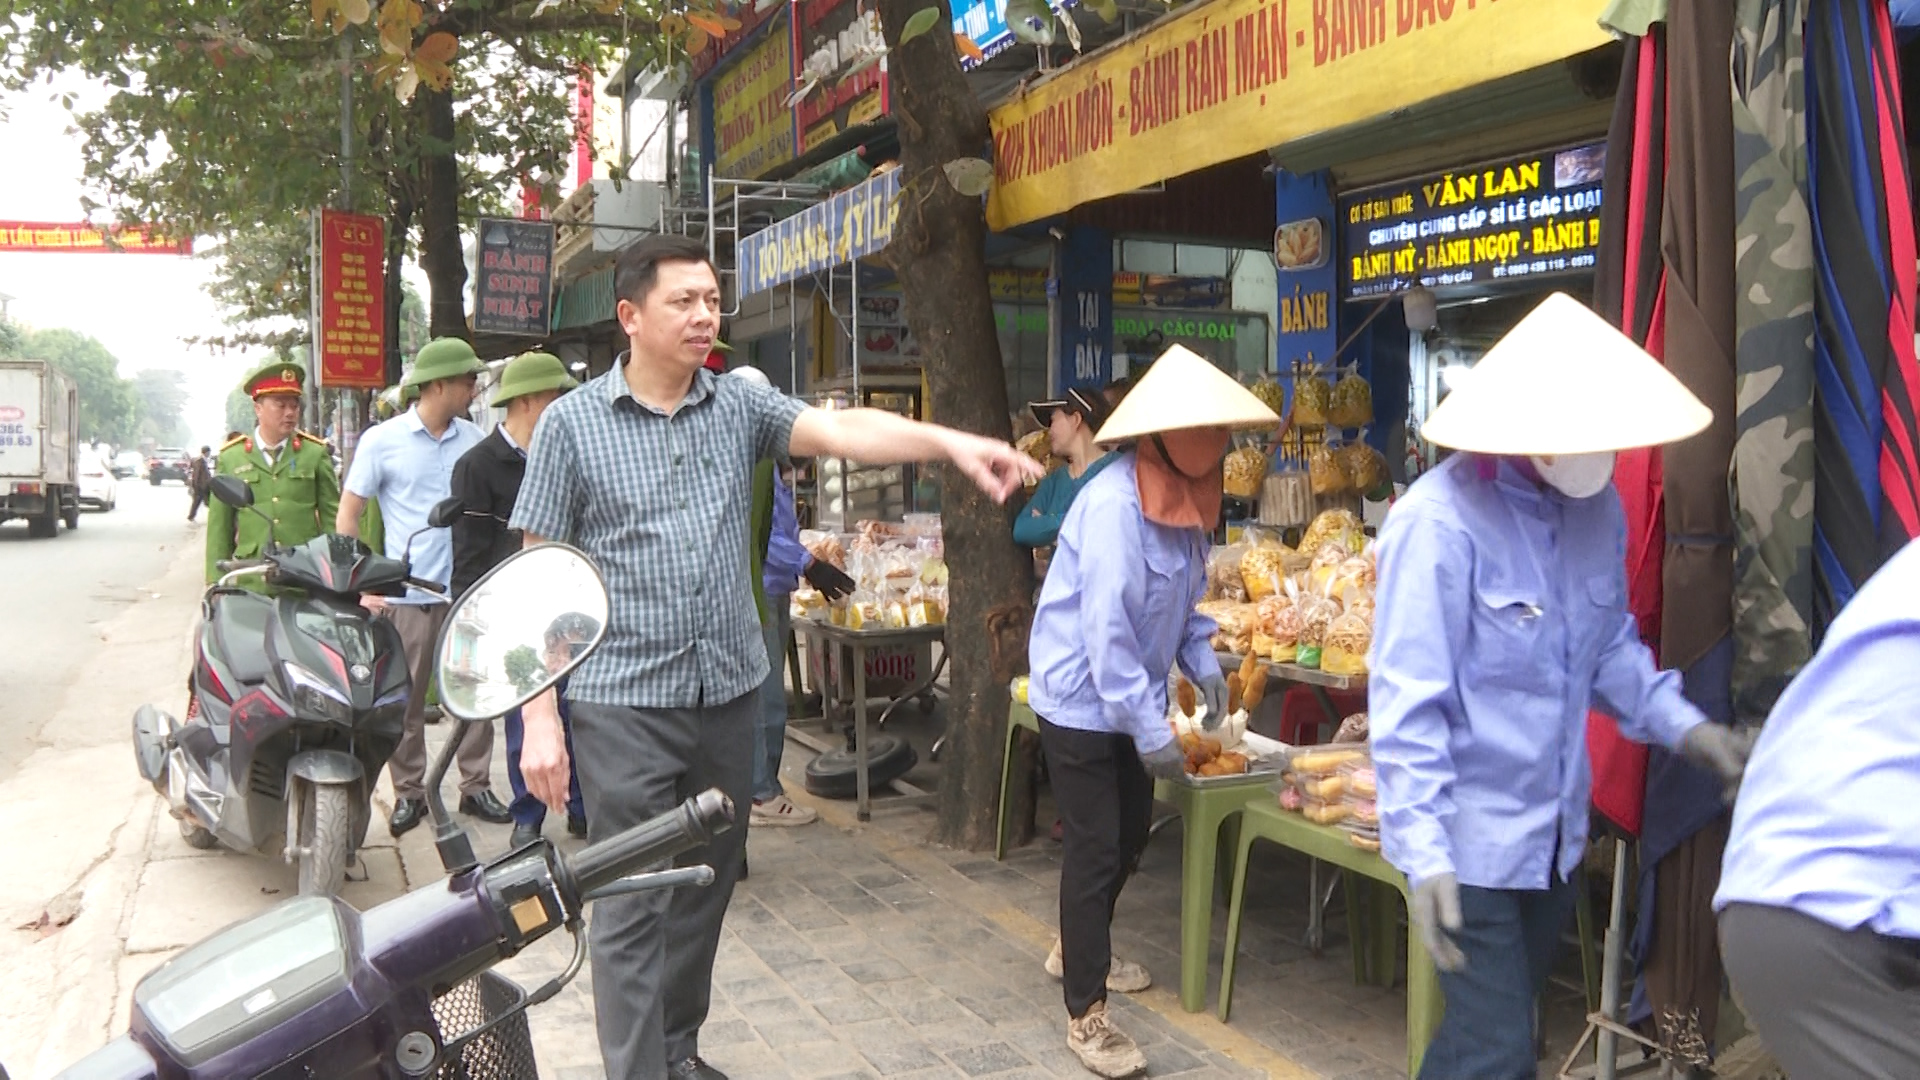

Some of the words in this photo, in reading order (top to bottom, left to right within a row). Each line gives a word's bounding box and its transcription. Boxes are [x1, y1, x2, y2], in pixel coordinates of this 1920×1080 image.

[995, 117, 1025, 186] ÁNH
[1027, 96, 1072, 176] KHOAI
[1075, 69, 1113, 152] MÔN
[1129, 44, 1179, 138] BÁNH
[1186, 16, 1228, 115] RÁN
[1423, 170, 1478, 208] VĂN
[1483, 161, 1541, 198] LAN
[1369, 221, 1417, 246] CHUYÊN
[1420, 215, 1456, 238] CUNG
[1459, 205, 1487, 230] CẤP
[1529, 194, 1561, 219] CÁC
[1564, 189, 1602, 213] LOẠI
[1352, 249, 1392, 281] BÁNH
[1426, 236, 1470, 270] BÁNH
[1473, 231, 1521, 265] NGỌT
[1532, 217, 1585, 254] BÁNH
[488, 272, 540, 294] SINH
[483, 295, 543, 321] NHẬT
[1077, 291, 1100, 331] TẠI
[1114, 318, 1154, 338] HOẠI
[1164, 316, 1195, 336] CÁC
[1199, 321, 1236, 340] LOẠI
[1281, 283, 1328, 333] BÁNH
